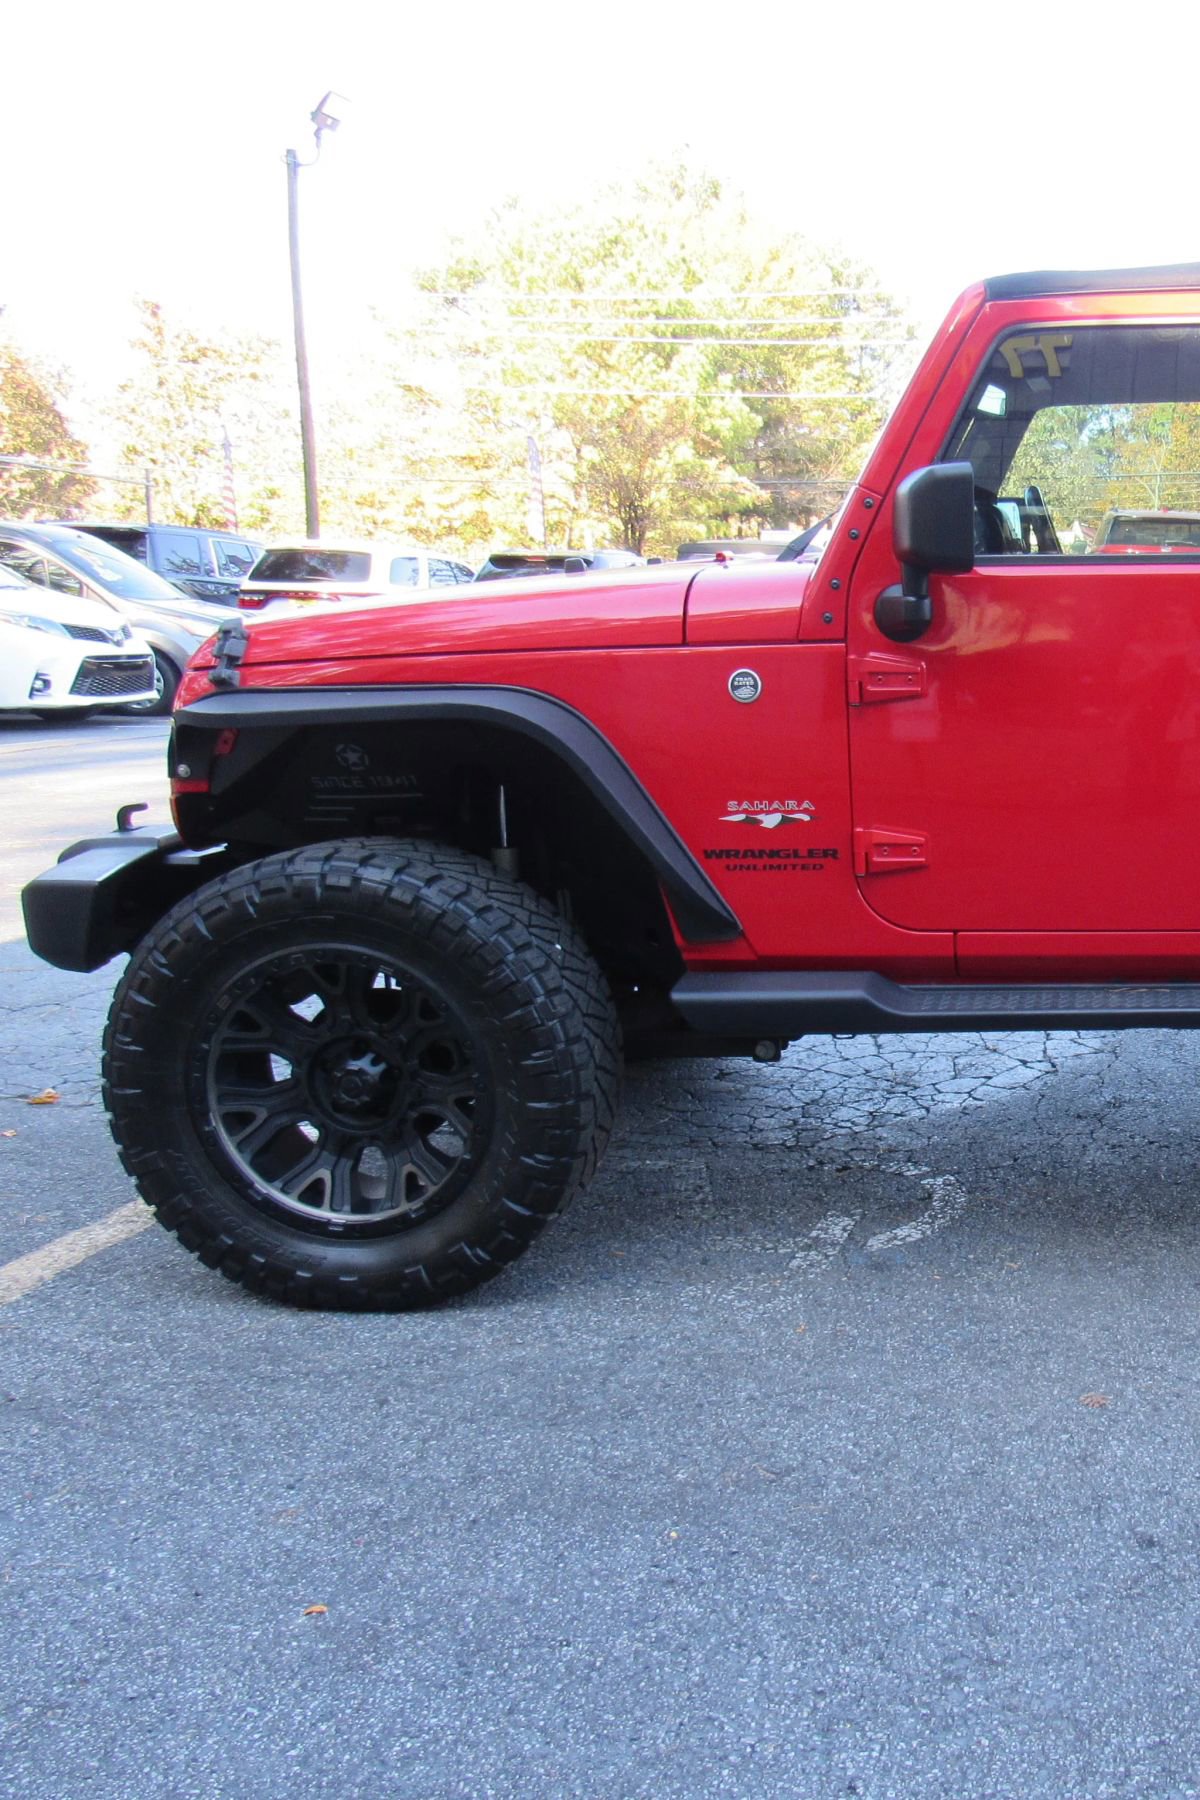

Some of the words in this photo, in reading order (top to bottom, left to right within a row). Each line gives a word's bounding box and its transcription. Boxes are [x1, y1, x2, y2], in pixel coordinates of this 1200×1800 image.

[727, 800, 815, 811] SAHARA
[703, 848, 839, 860] WRANGLER
[725, 863, 824, 871] UNLIMITED
